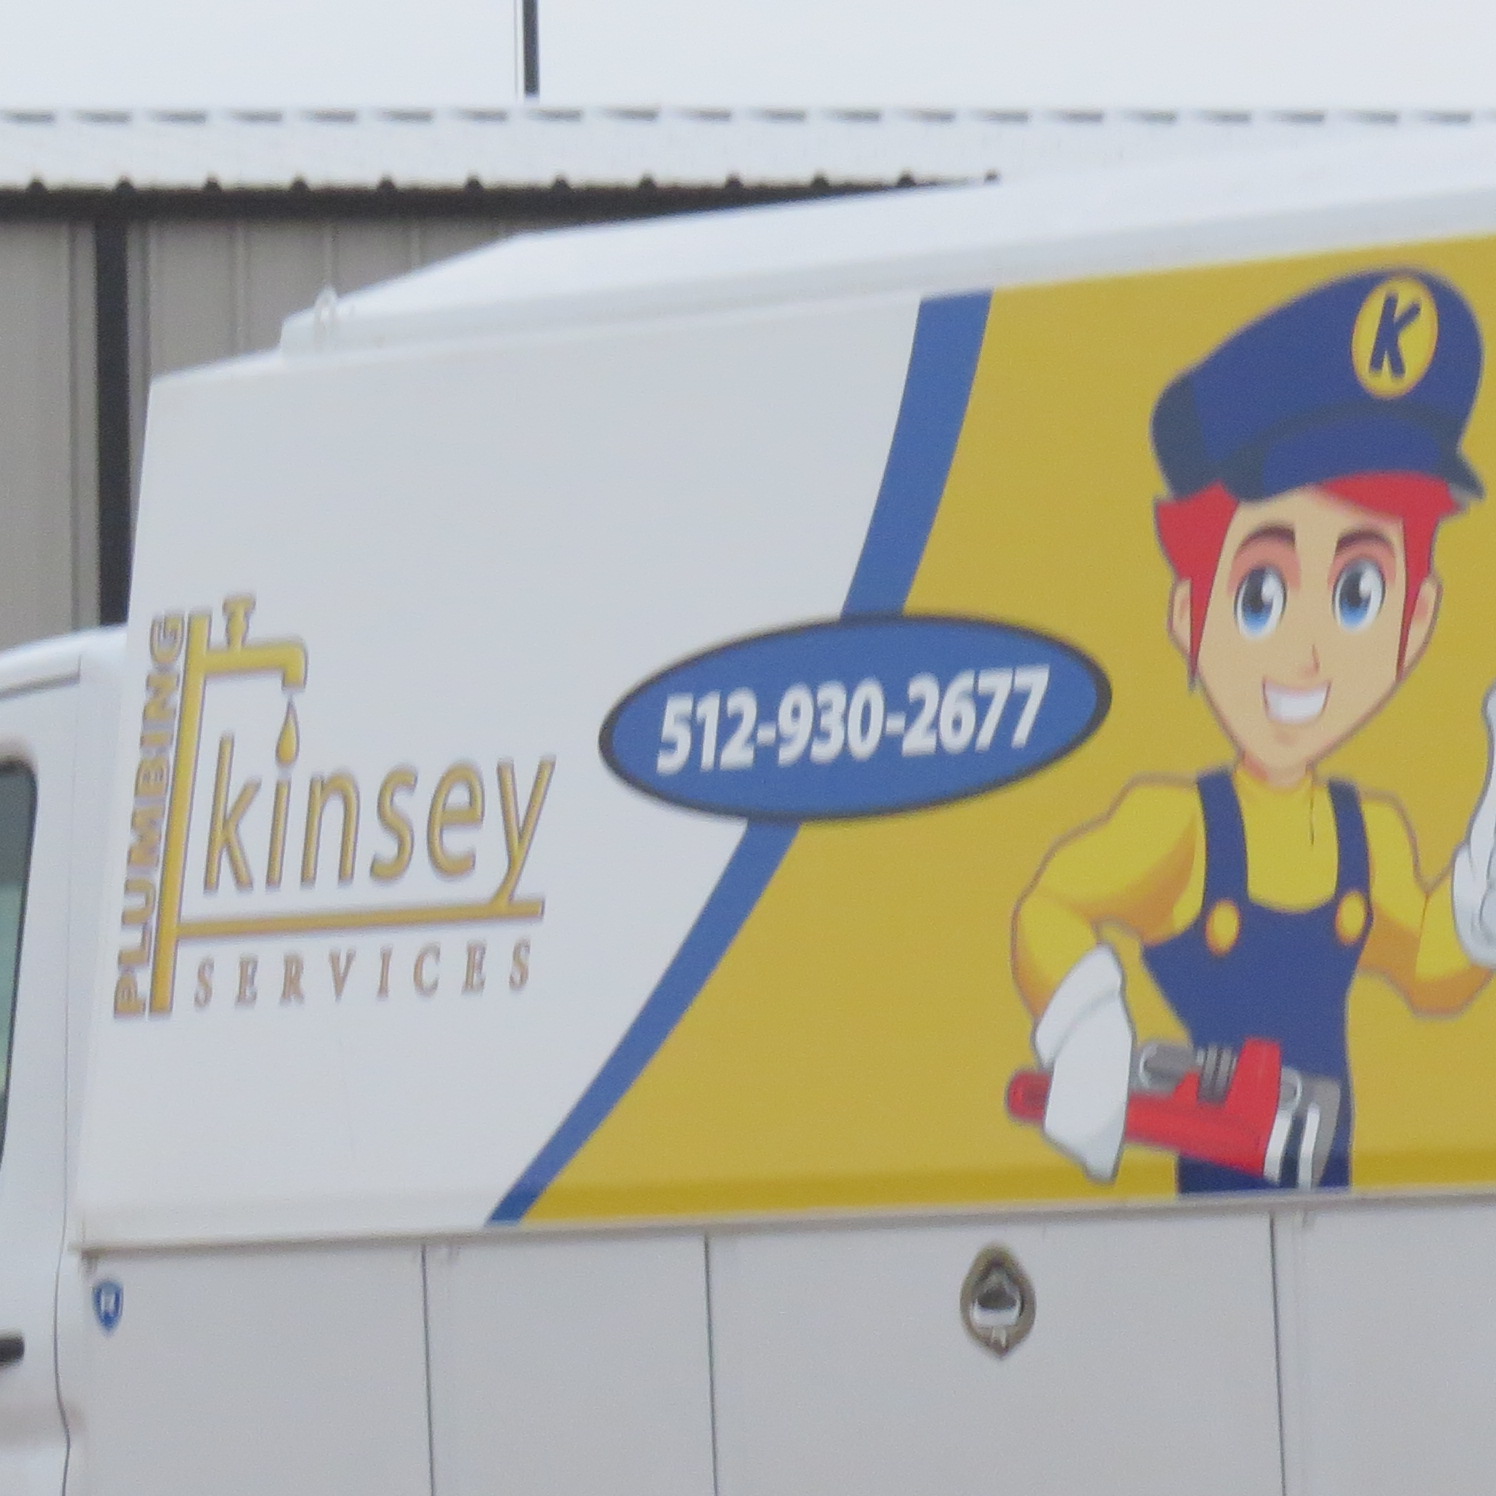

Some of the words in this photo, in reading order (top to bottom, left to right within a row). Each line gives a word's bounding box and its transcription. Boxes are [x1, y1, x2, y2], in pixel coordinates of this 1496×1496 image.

[1369, 292, 1421, 380] K
[656, 664, 1051, 776] 512-930-2677
[113, 612, 187, 1019] PLUMBING
[203, 728, 557, 912] kinsey
[193, 937, 532, 1011] SERVICES
